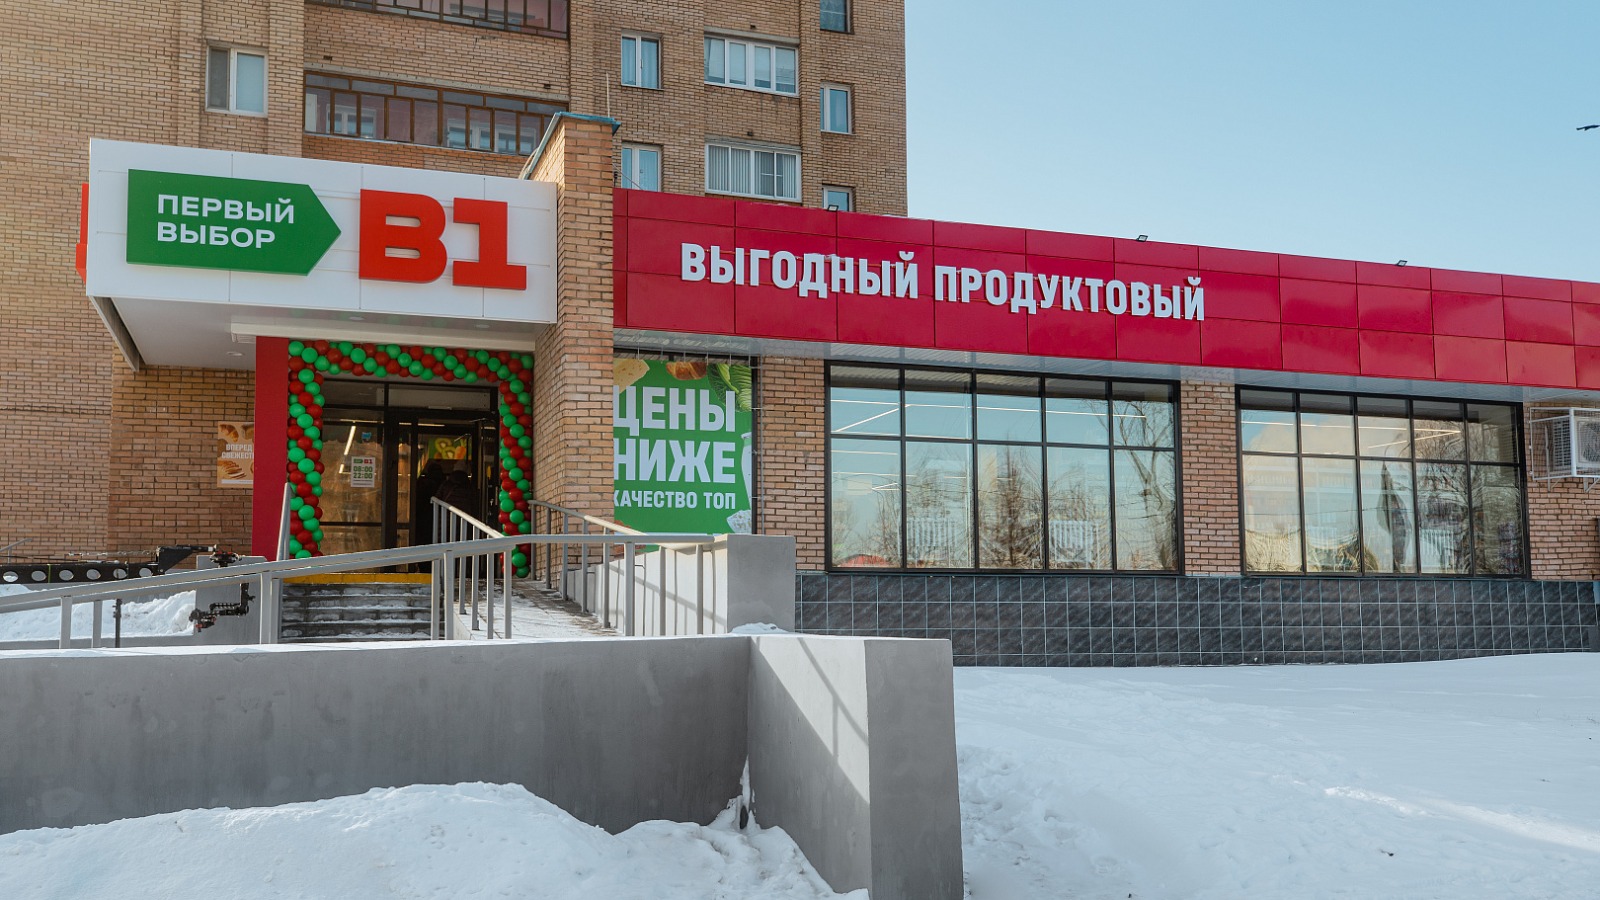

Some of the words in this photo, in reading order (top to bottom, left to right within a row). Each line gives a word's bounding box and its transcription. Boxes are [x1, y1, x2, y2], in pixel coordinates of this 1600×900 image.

[157, 193, 295, 225] ПЕРВЫЙ
[157, 221, 276, 249] ВЫБОР
[358, 188, 527, 291] В1
[681, 242, 919, 299] ВЫГОДНЫЙ
[934, 264, 1205, 322] ПРОДУКТОВЫЙ
[613, 385, 736, 437] ЦЕНЫ
[221, 451, 255, 459] СВЕЖЕСТ
[613, 438, 736, 484] НИЖЕ
[703, 492, 736, 510] ТОП
